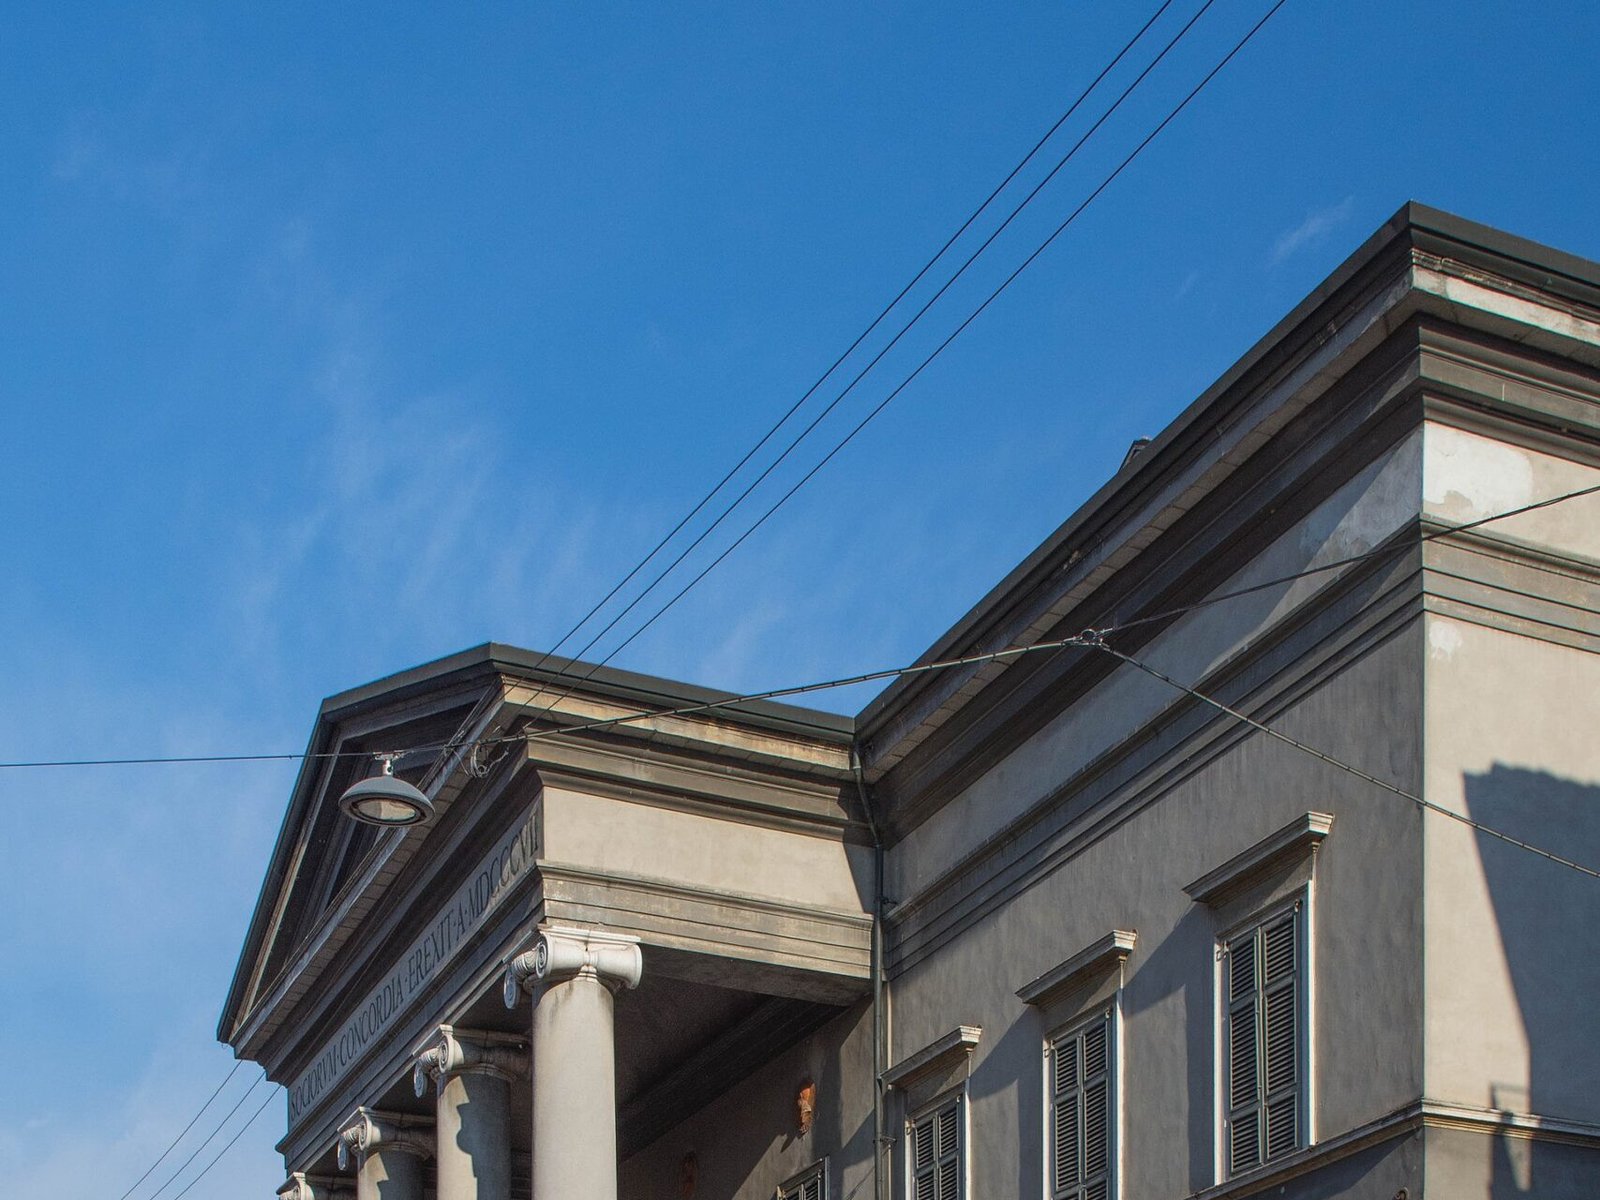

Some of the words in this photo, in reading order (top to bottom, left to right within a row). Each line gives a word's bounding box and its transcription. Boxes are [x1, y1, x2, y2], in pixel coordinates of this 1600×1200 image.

[290, 1045, 338, 1122] SOCIORVM
[339, 974, 405, 1067] CONCORDIA
[408, 908, 454, 994] EREXIT
[456, 902, 466, 942] A
